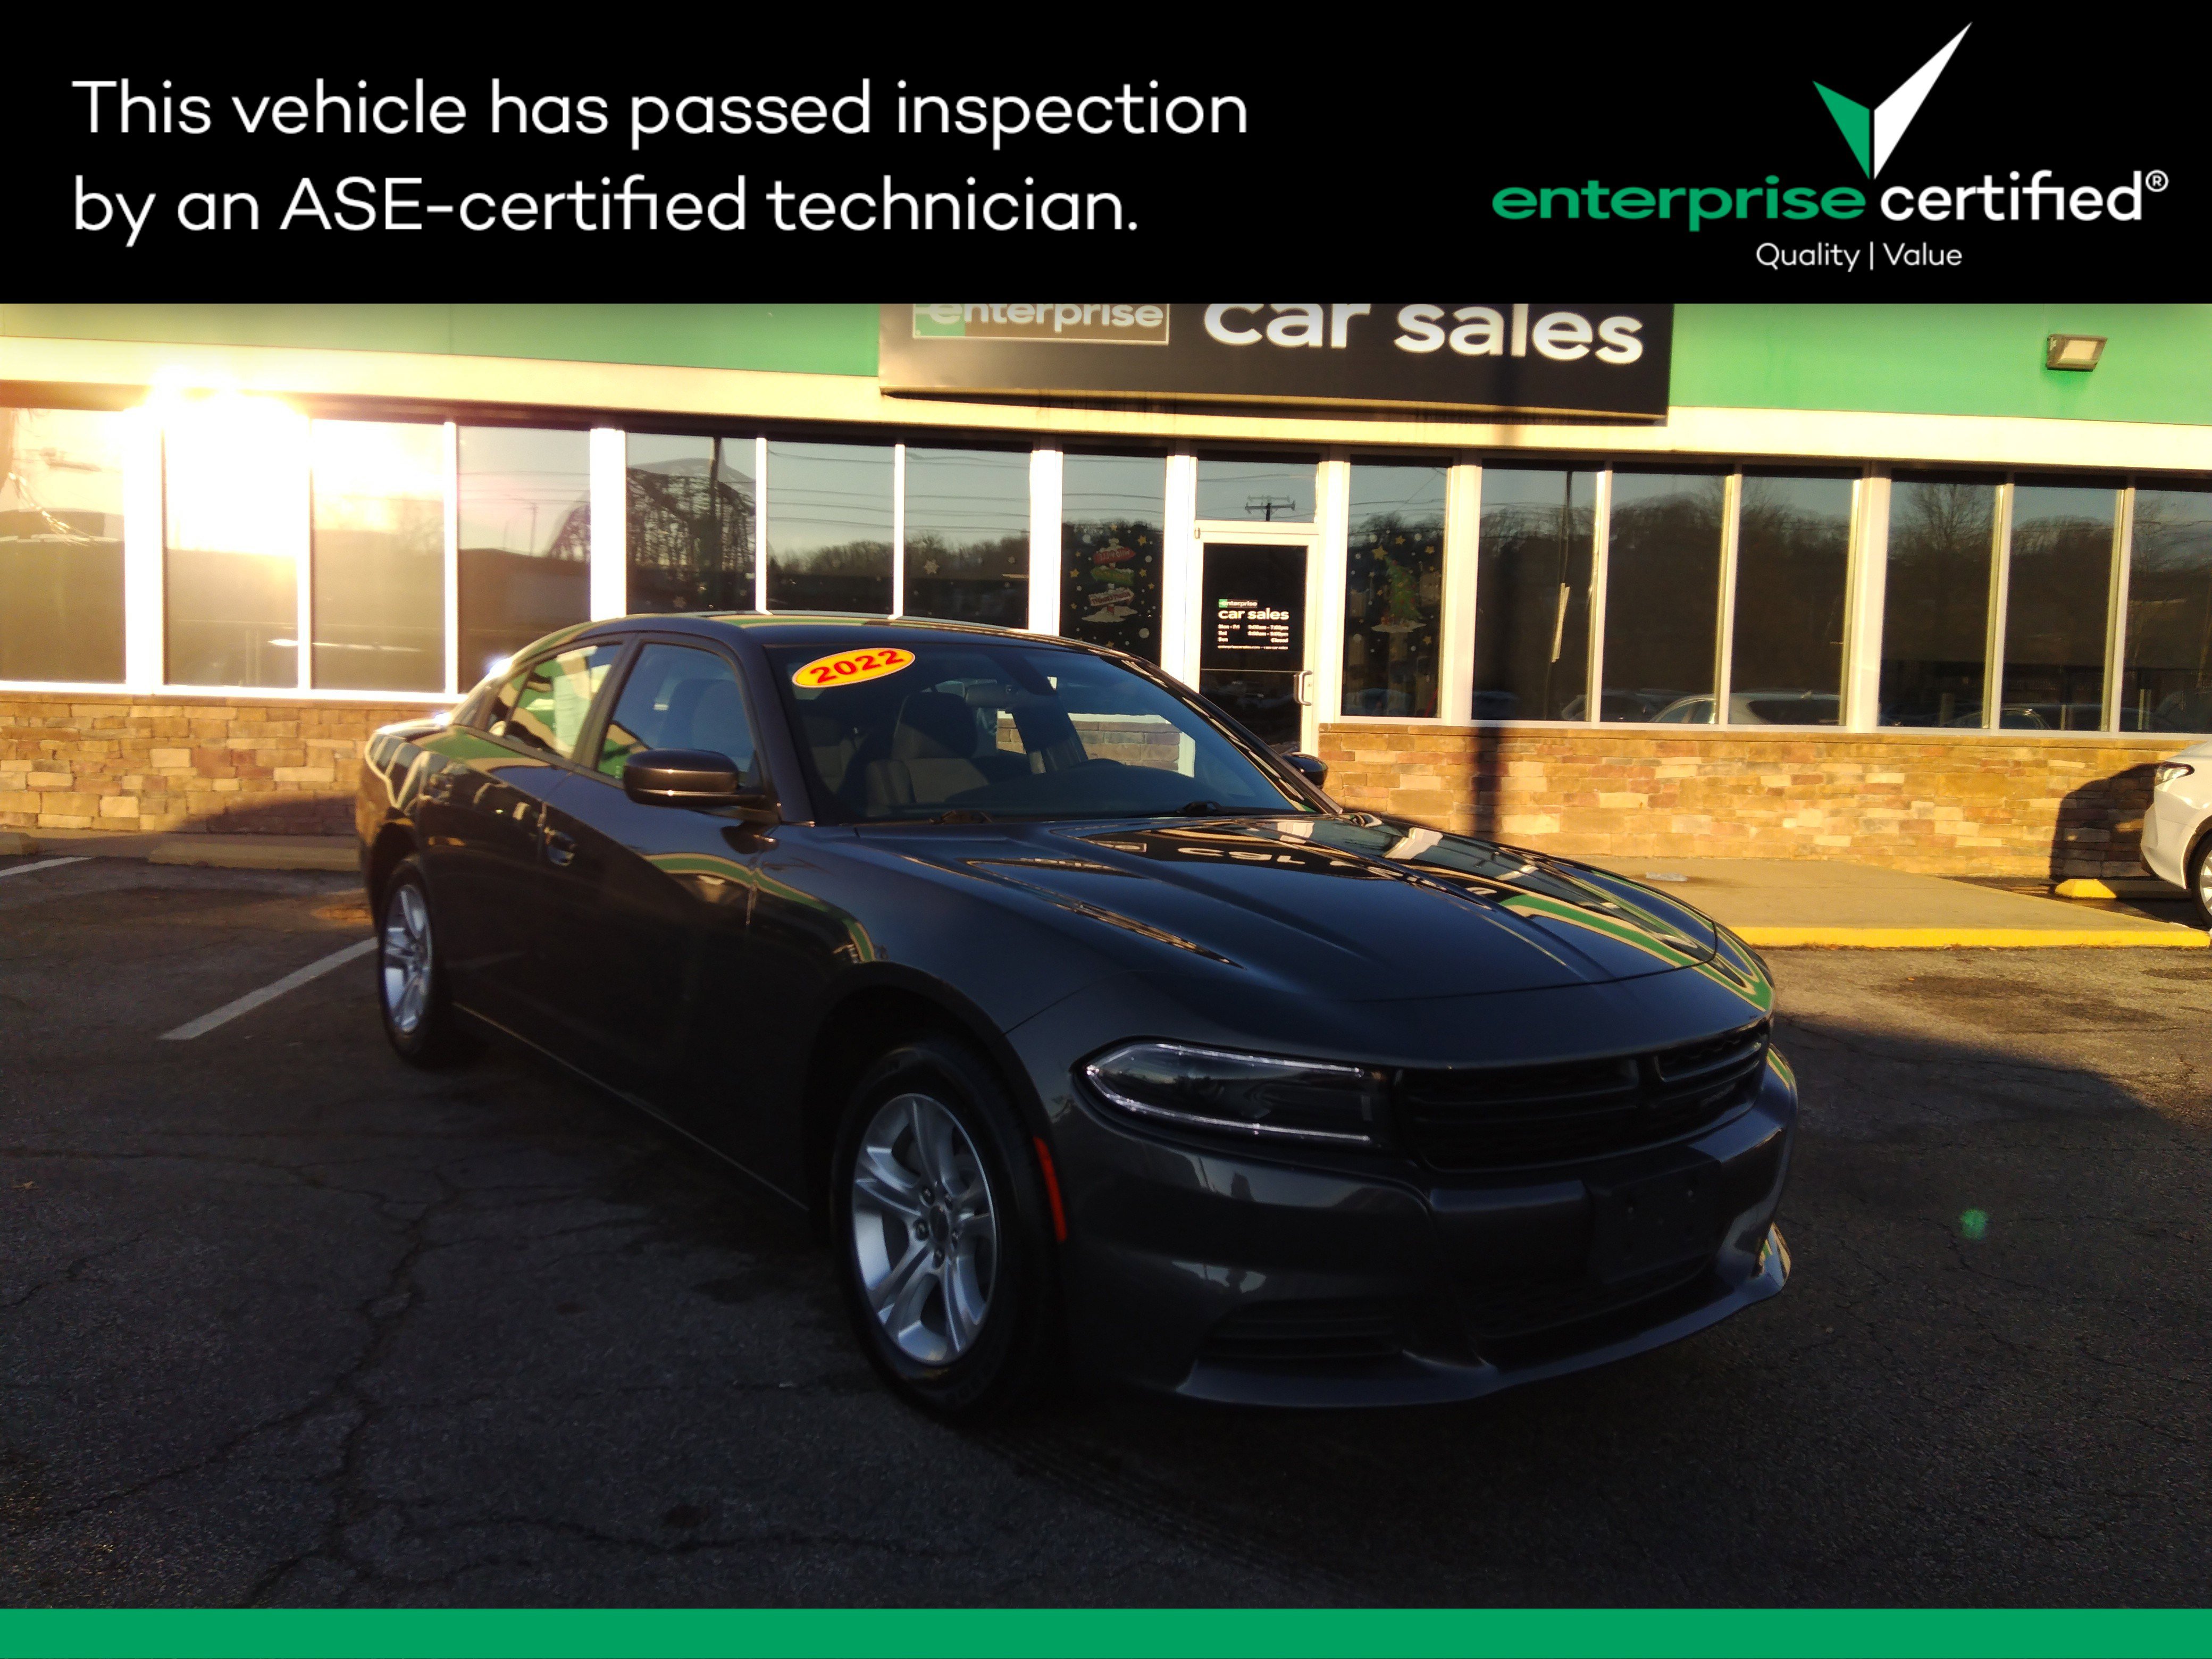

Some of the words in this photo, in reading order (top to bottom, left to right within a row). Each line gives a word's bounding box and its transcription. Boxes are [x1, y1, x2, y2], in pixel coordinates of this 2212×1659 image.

[929, 304, 1163, 333] enterprise
[1204, 304, 1370, 348] car
[1394, 304, 1644, 364] sales
[1218, 610, 1245, 619] car
[1247, 607, 1289, 620] sales
[810, 650, 904, 683] 2022
